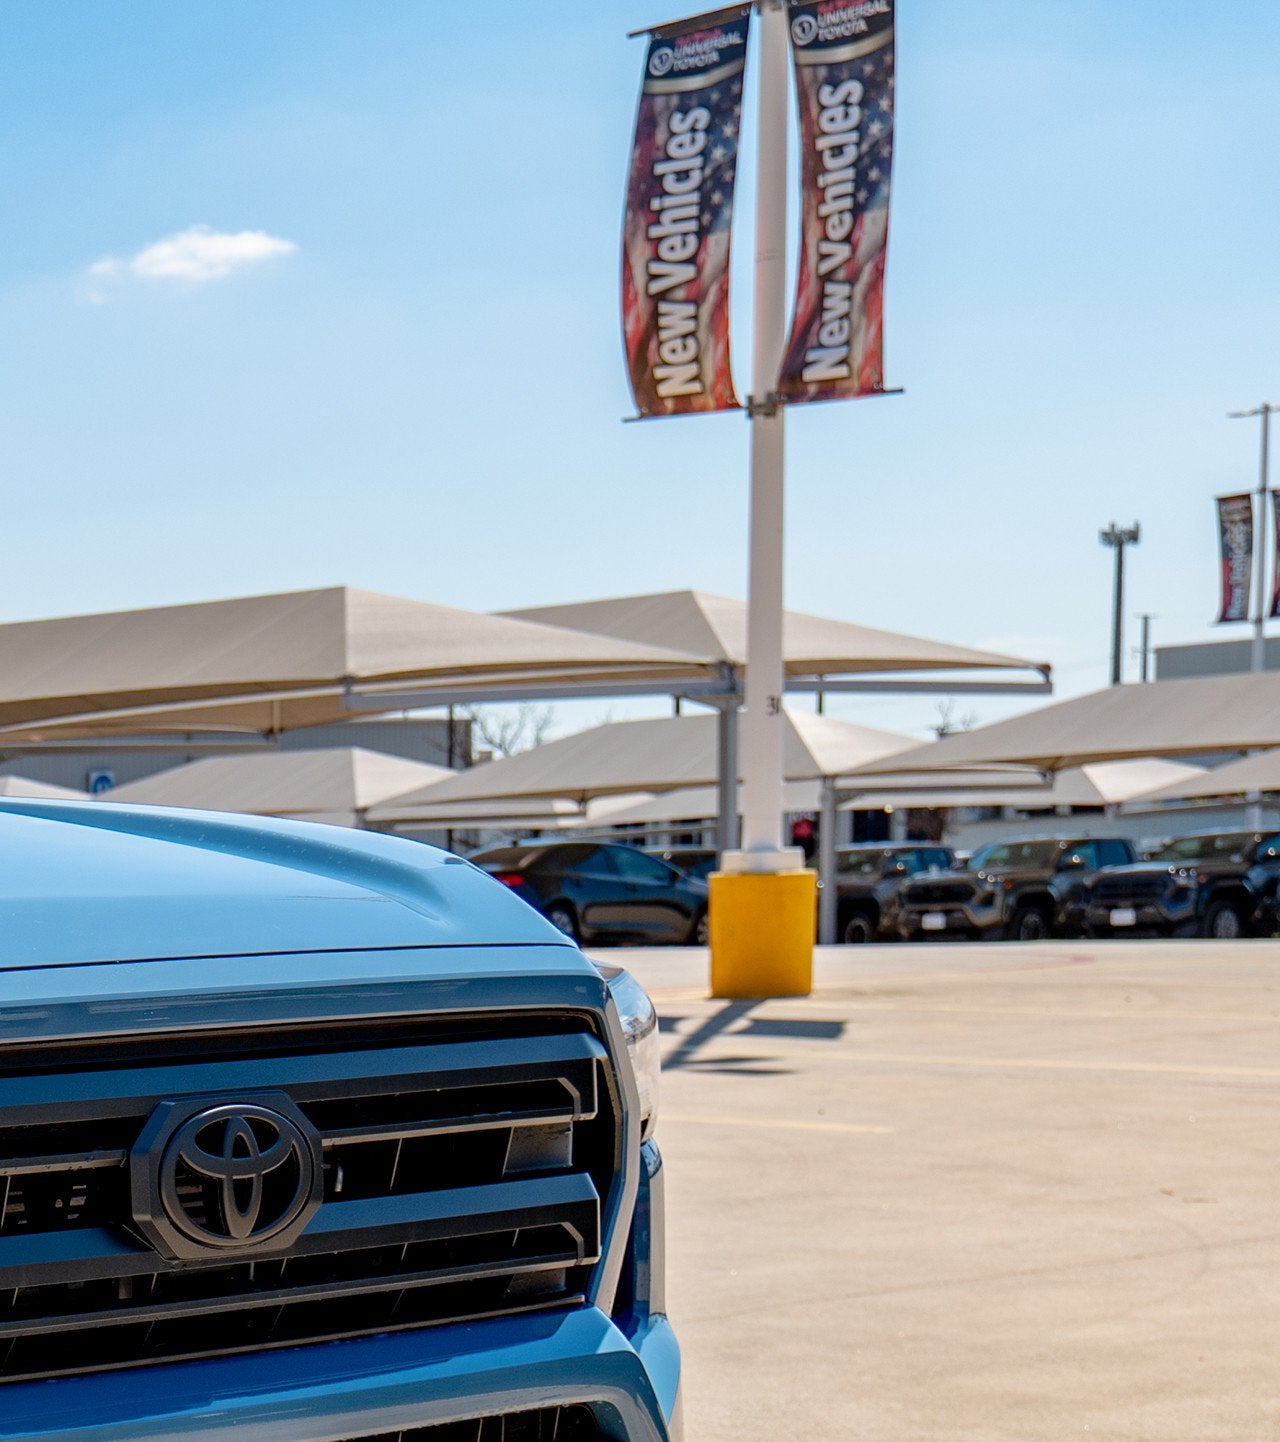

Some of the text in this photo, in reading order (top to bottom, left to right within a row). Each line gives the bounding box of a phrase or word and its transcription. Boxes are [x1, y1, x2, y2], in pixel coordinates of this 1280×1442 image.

[817, 0, 891, 27] UNIVERSAL
[818, 18, 868, 41] TOYOTA
[673, 51, 720, 71] TOYOTA
[646, 106, 710, 296] Vehicles
[802, 79, 864, 381] New Vehicles
[652, 300, 702, 398] New
